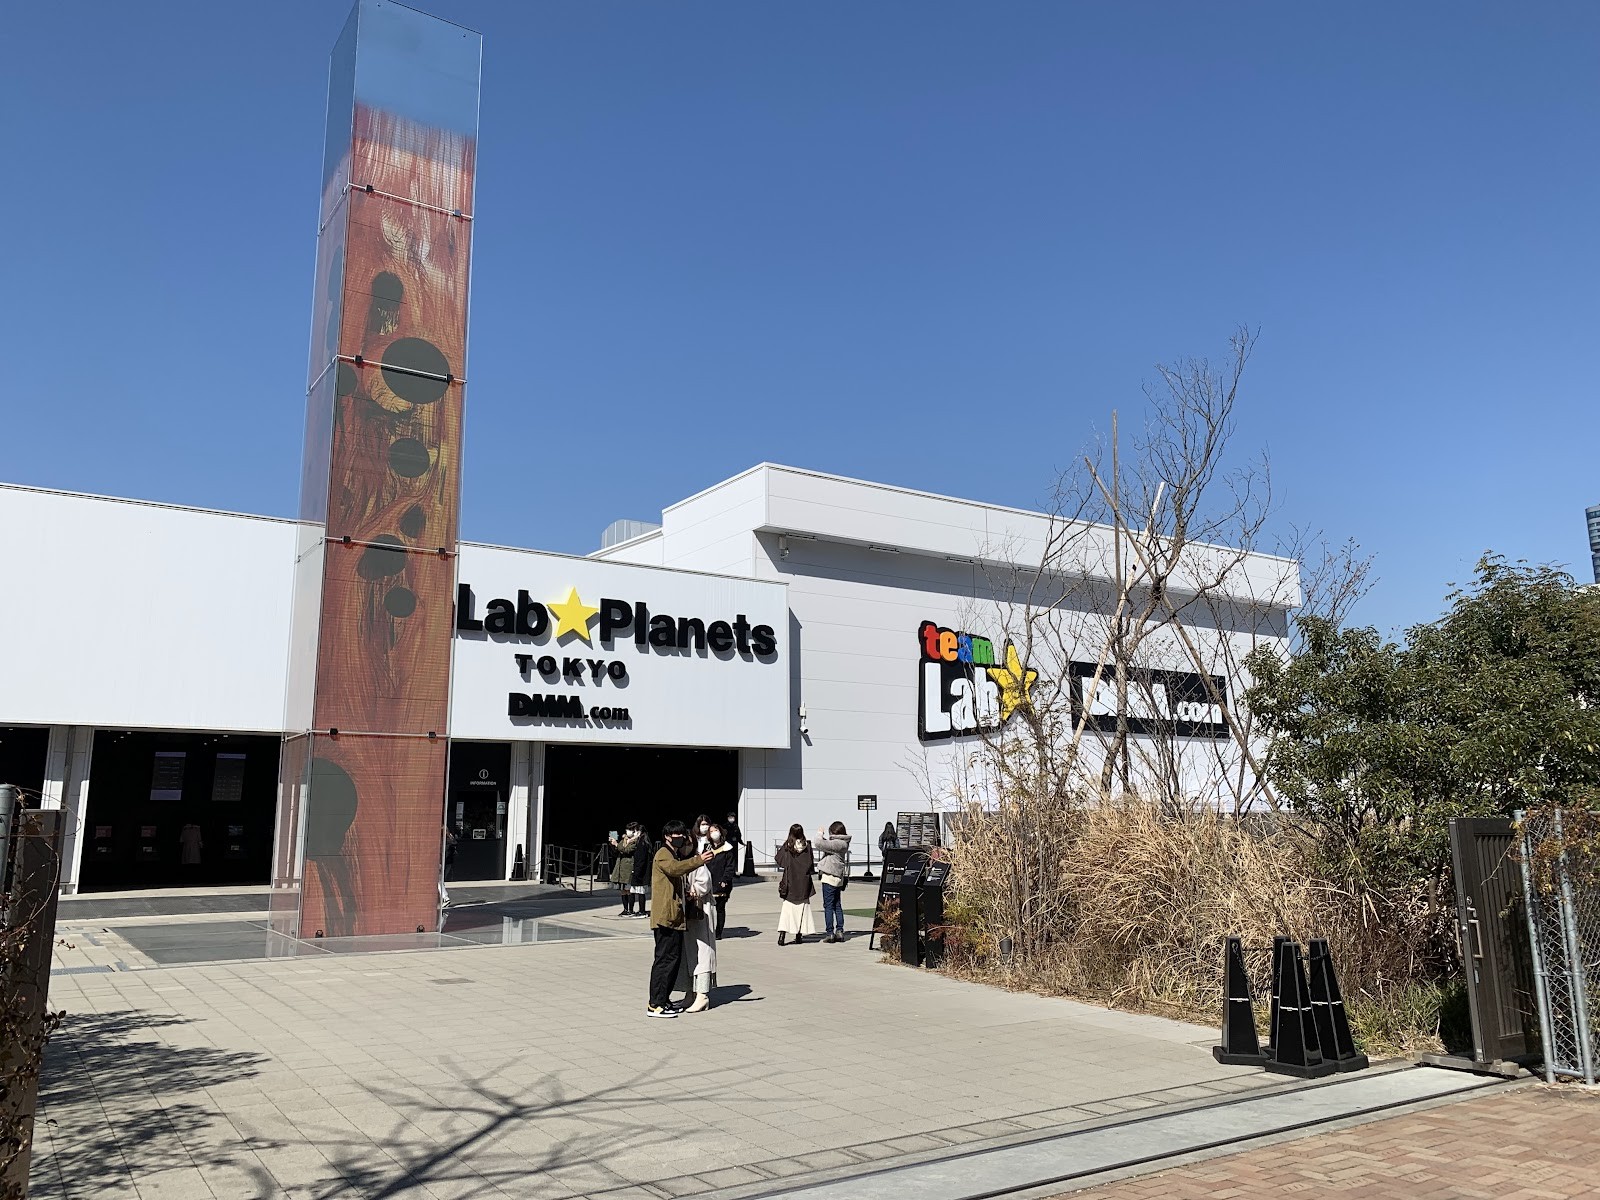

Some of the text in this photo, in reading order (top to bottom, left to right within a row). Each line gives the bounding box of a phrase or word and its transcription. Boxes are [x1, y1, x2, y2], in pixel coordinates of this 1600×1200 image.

[457, 583, 776, 655] Lab Planets
[924, 623, 994, 665] team
[515, 654, 626, 680] TOKYO
[508, 692, 629, 720] DMM.com
[925, 662, 1001, 732] Lab
